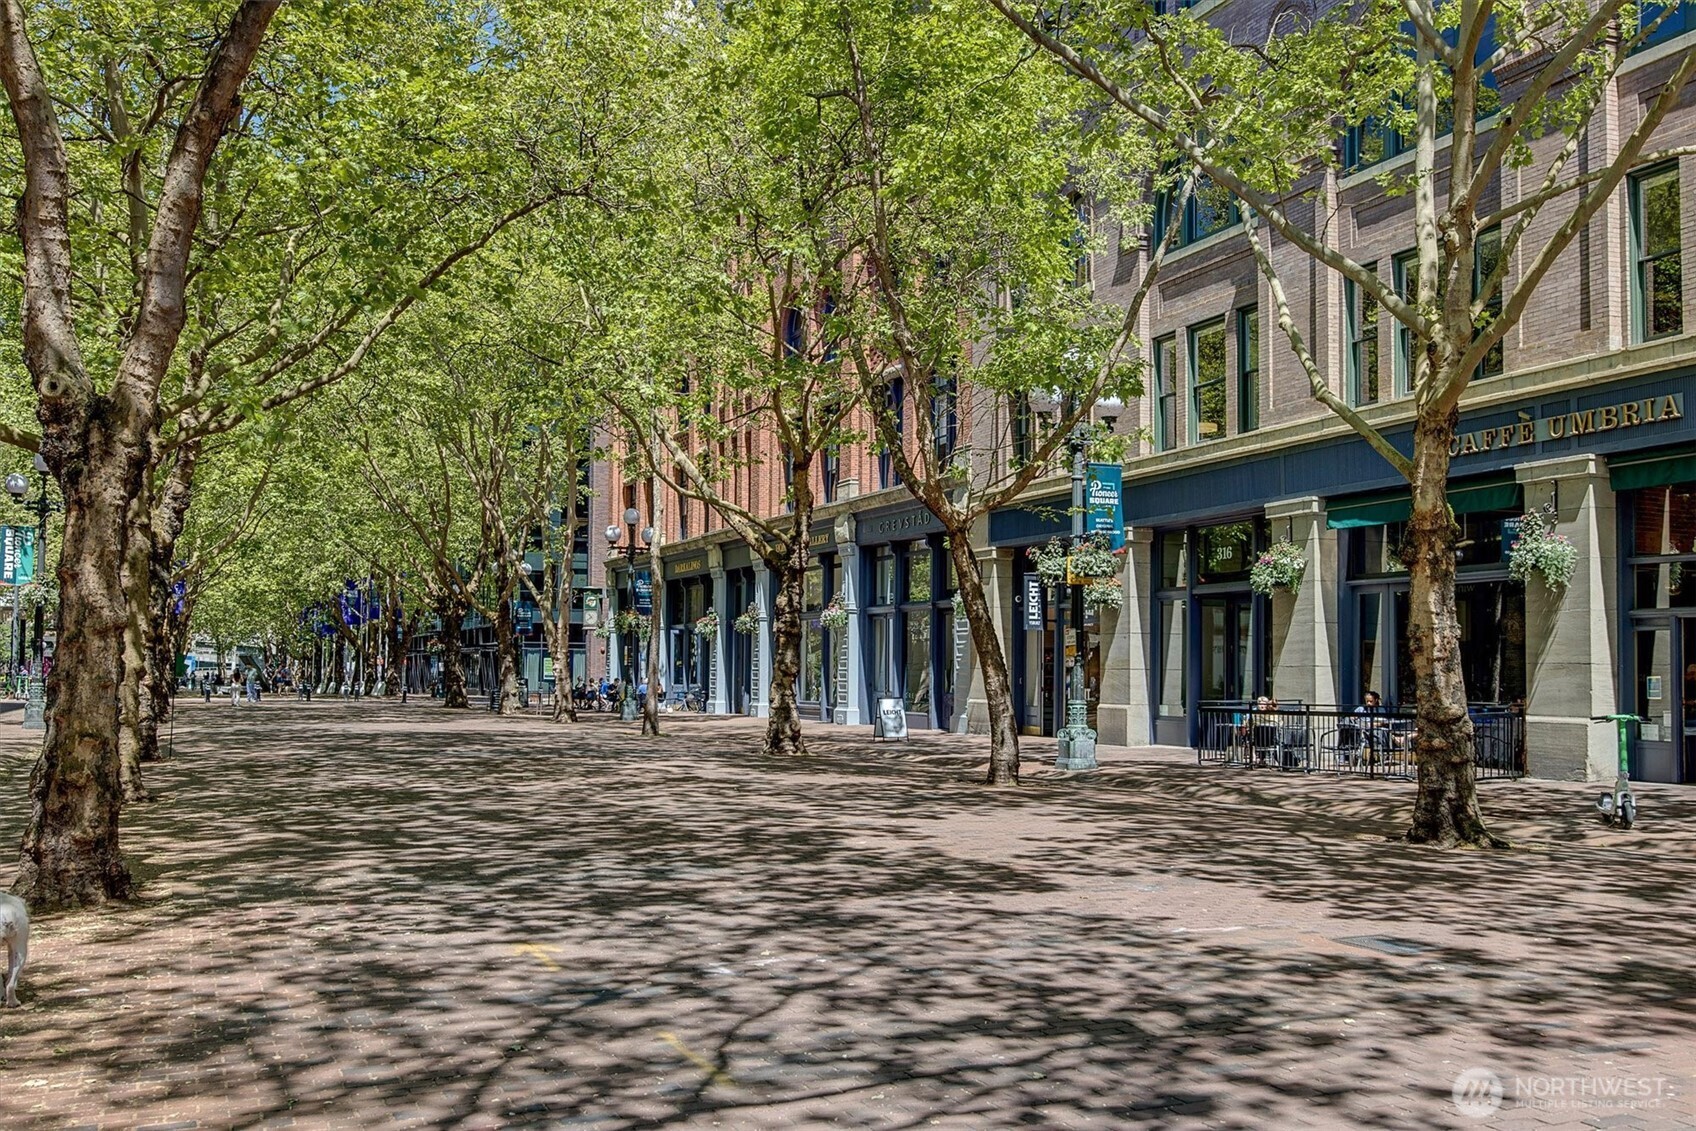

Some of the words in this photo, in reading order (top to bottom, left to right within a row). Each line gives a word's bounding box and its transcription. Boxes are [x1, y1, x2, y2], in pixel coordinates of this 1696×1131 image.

[1448, 411, 1535, 457] CAFFÈ
[1548, 394, 1683, 440] UMBRIA
[1089, 480, 1119, 497] Pioneer
[1089, 497, 1119, 505] SQUARE
[1216, 546, 1233, 560] 316
[1028, 581, 1038, 620] LEICHT
